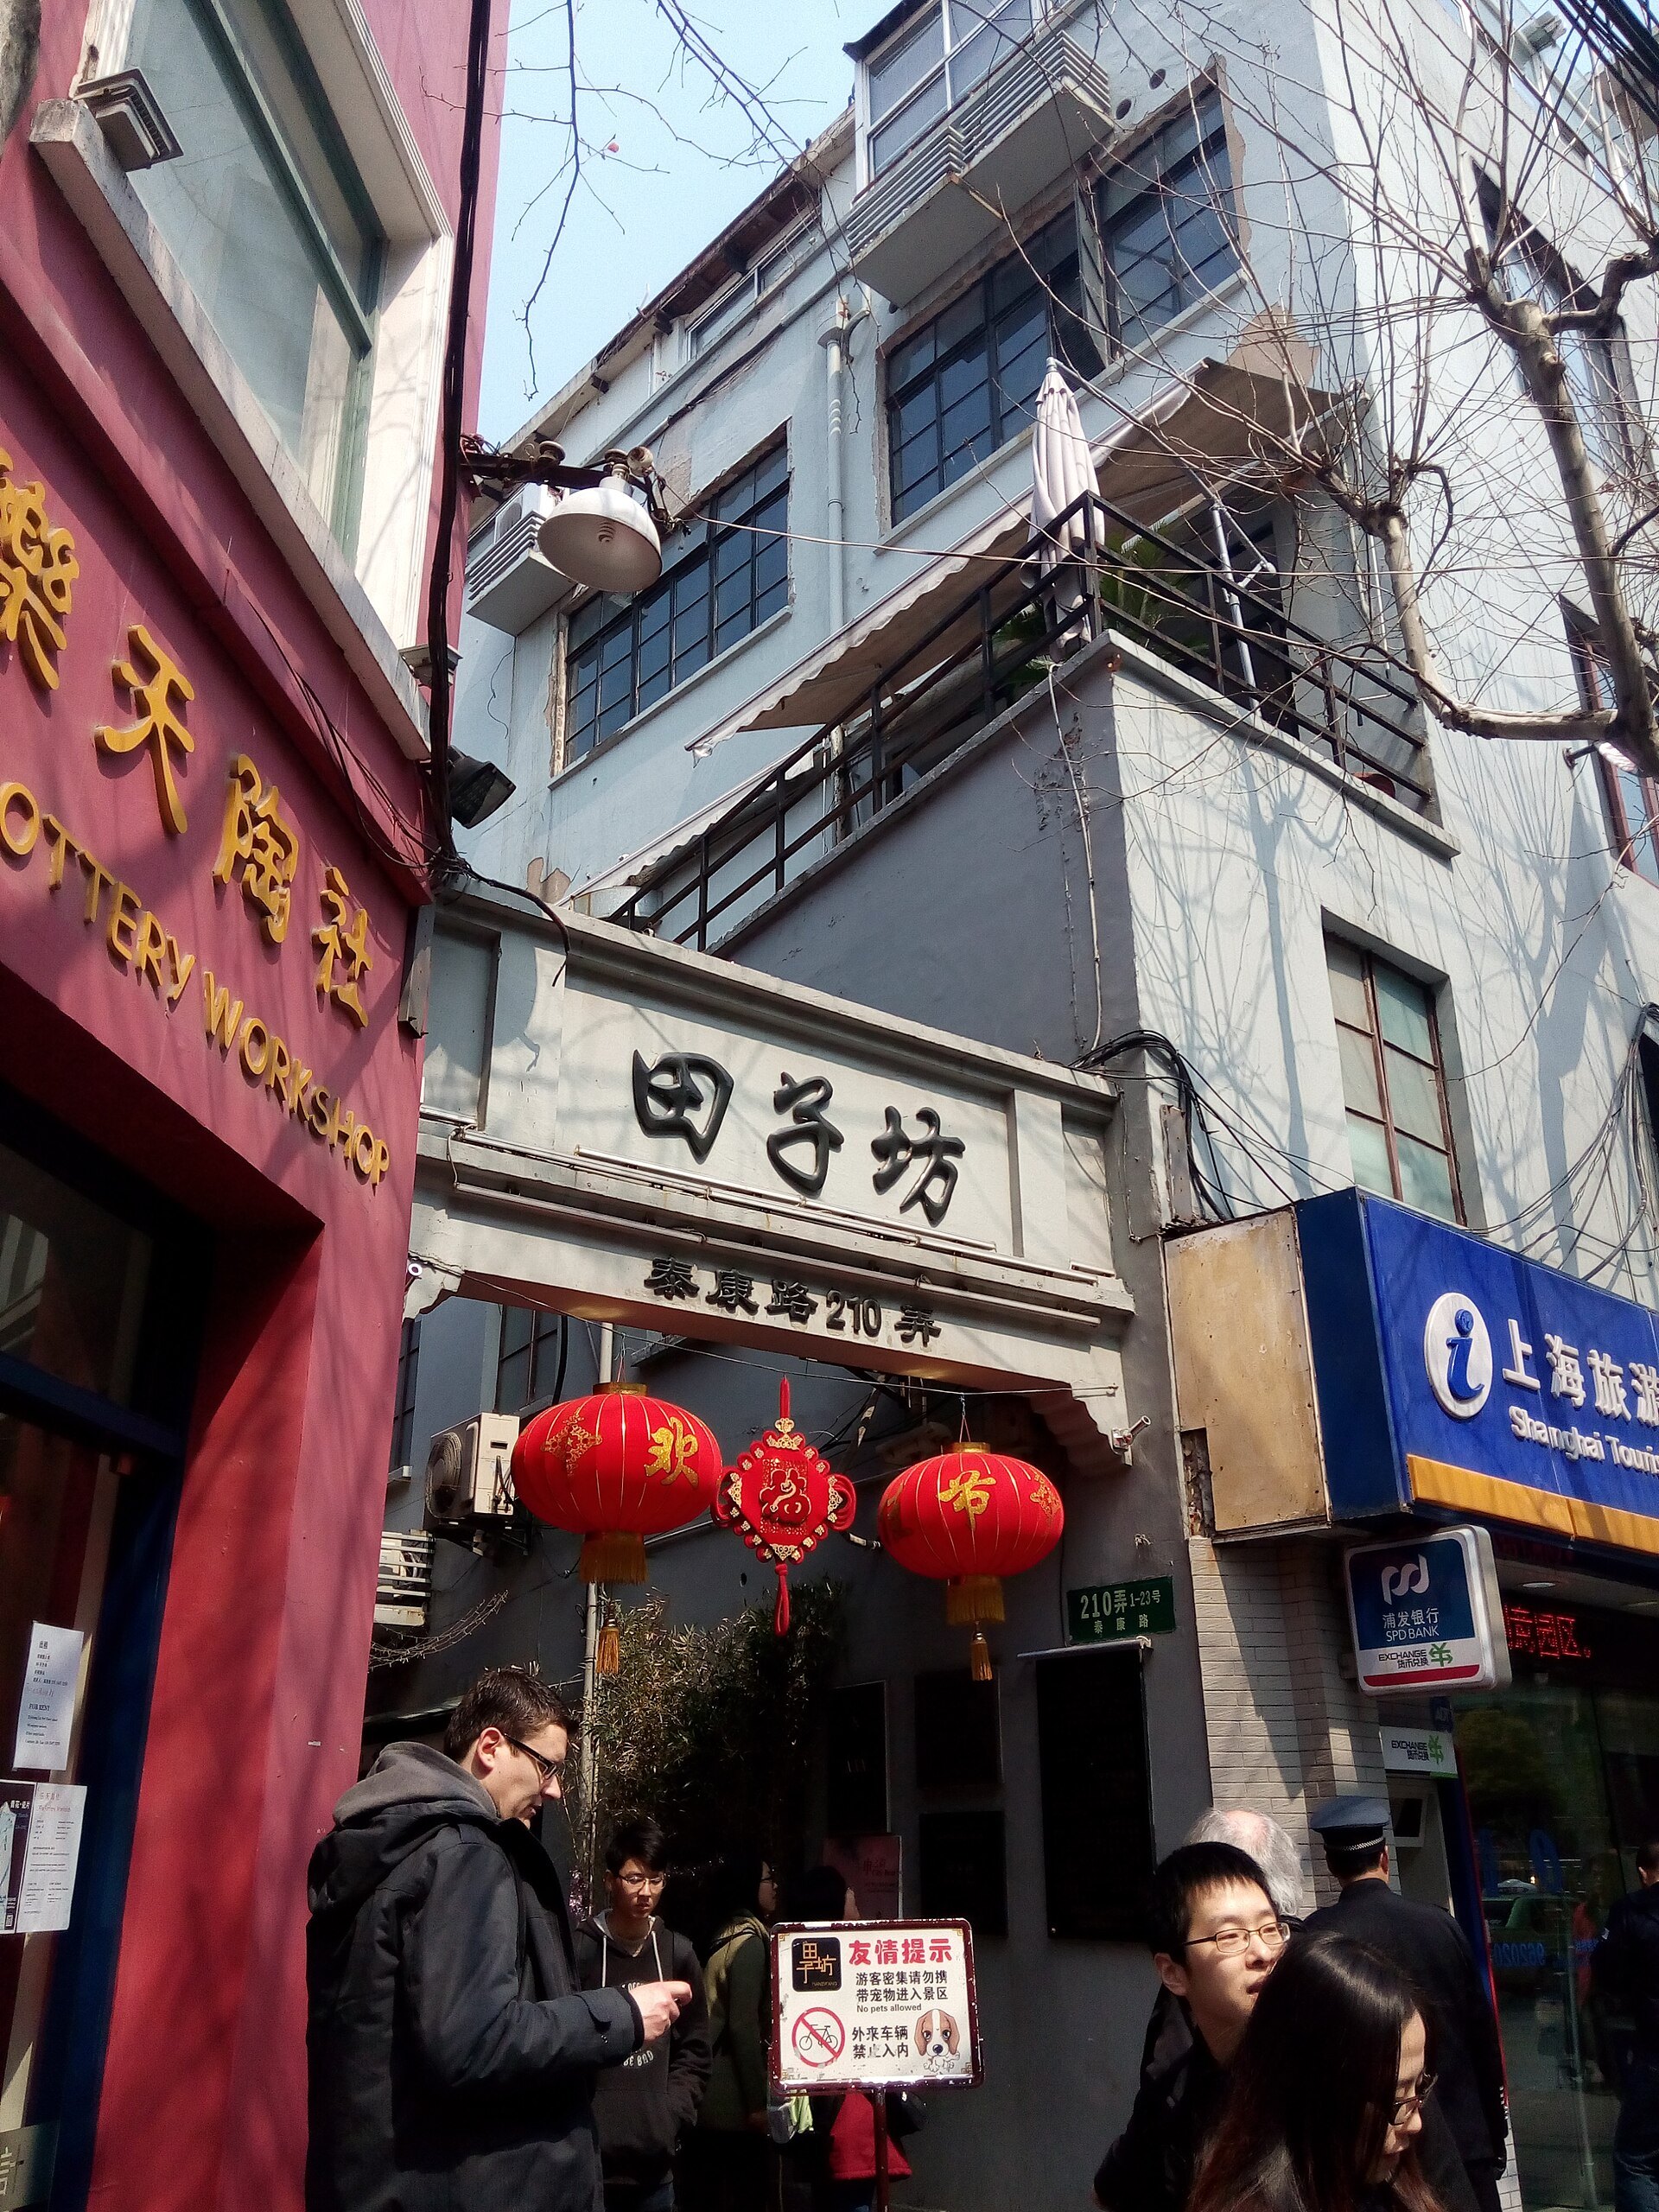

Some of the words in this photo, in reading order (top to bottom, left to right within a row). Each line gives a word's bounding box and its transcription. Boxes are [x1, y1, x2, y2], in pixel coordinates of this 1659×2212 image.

[203, 971, 390, 1186] WORKSHOP
[632, 1049, 965, 1227] 田子坊
[643, 1256, 942, 1347] 泰康路210弄
[1509, 1405, 1605, 1462] Shanghai
[644, 1415, 699, 1489] 欢
[1093, 1613, 1148, 1635] 泰康路
[1382, 1607, 1440, 1629] 浦发银行
[1385, 1629, 1407, 1642] SPD
[1408, 1624, 1440, 1639] BANK
[1378, 1649, 1427, 1662] EXCHANGE
[1396, 1657, 1429, 1669] 货币兑换
[1390, 1739, 1428, 1751] EXCHANGE
[849, 1938, 951, 1966] 友情提示
[855, 1970, 948, 1986] 游客密集请勿携
[856, 1986, 949, 2003] 带宠物进入景区
[870, 2005, 888, 2013] pets
[890, 2003, 922, 2012] allowed
[851, 2025, 908, 2042] 外来车辆
